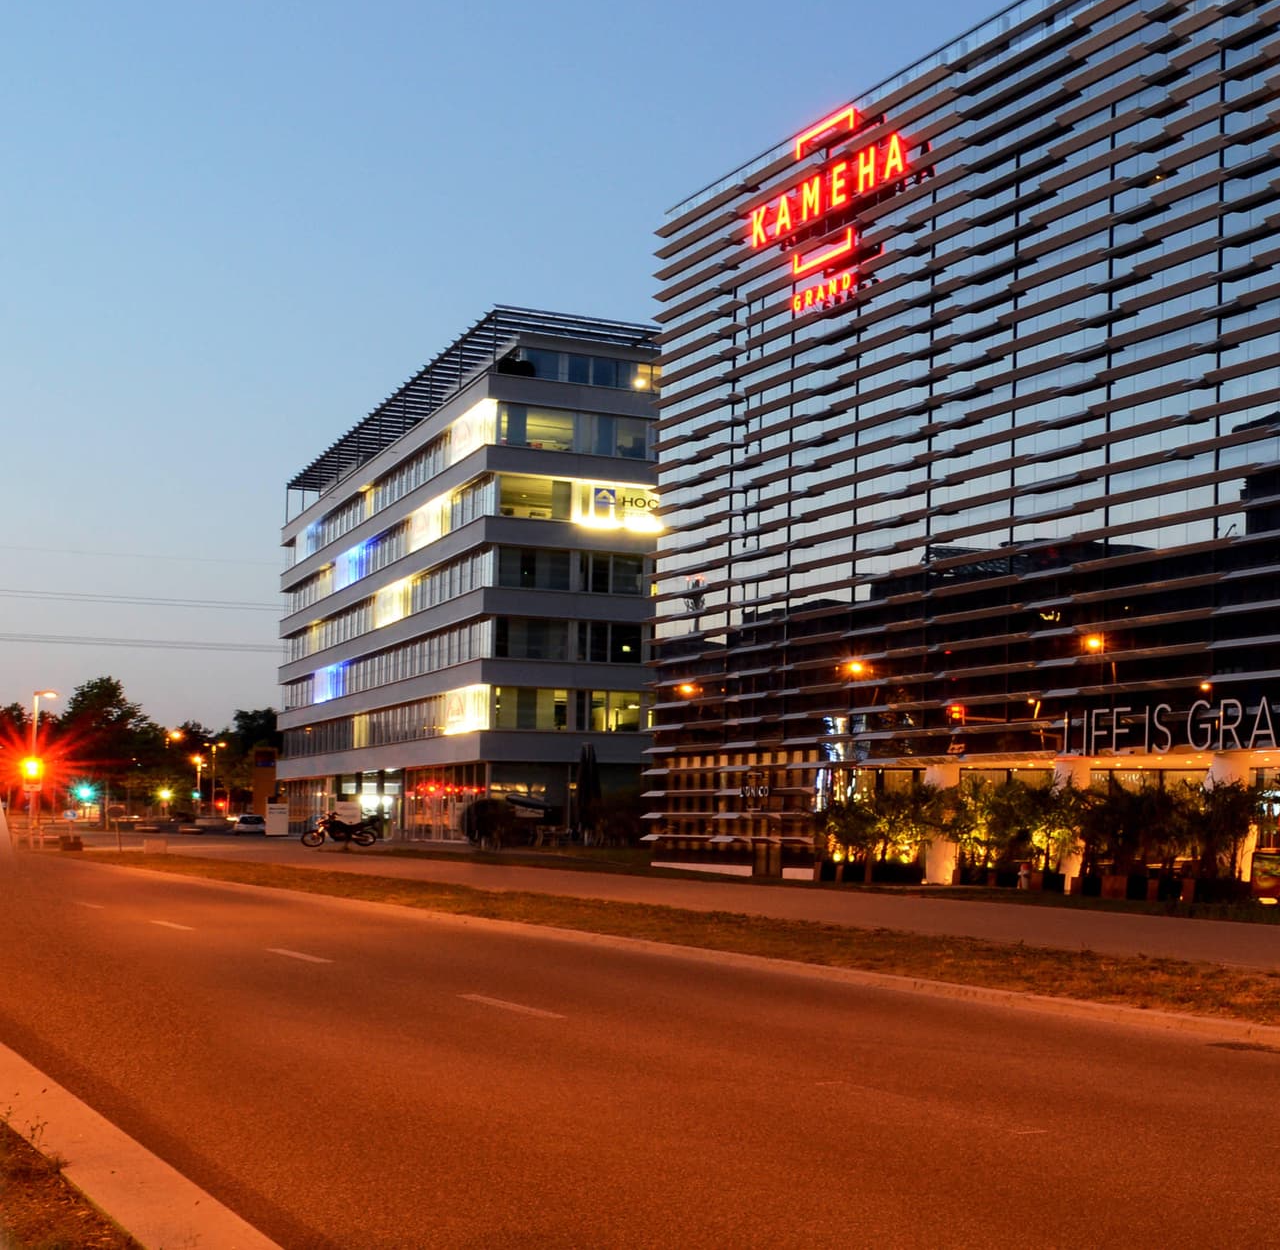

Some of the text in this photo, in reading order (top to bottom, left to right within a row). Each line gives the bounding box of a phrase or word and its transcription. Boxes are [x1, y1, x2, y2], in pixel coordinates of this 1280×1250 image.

[752, 134, 904, 248] KAMEHA
[793, 272, 851, 311] GRAND
[1063, 706, 1132, 756] LIFE
[1145, 703, 1172, 754] IS
